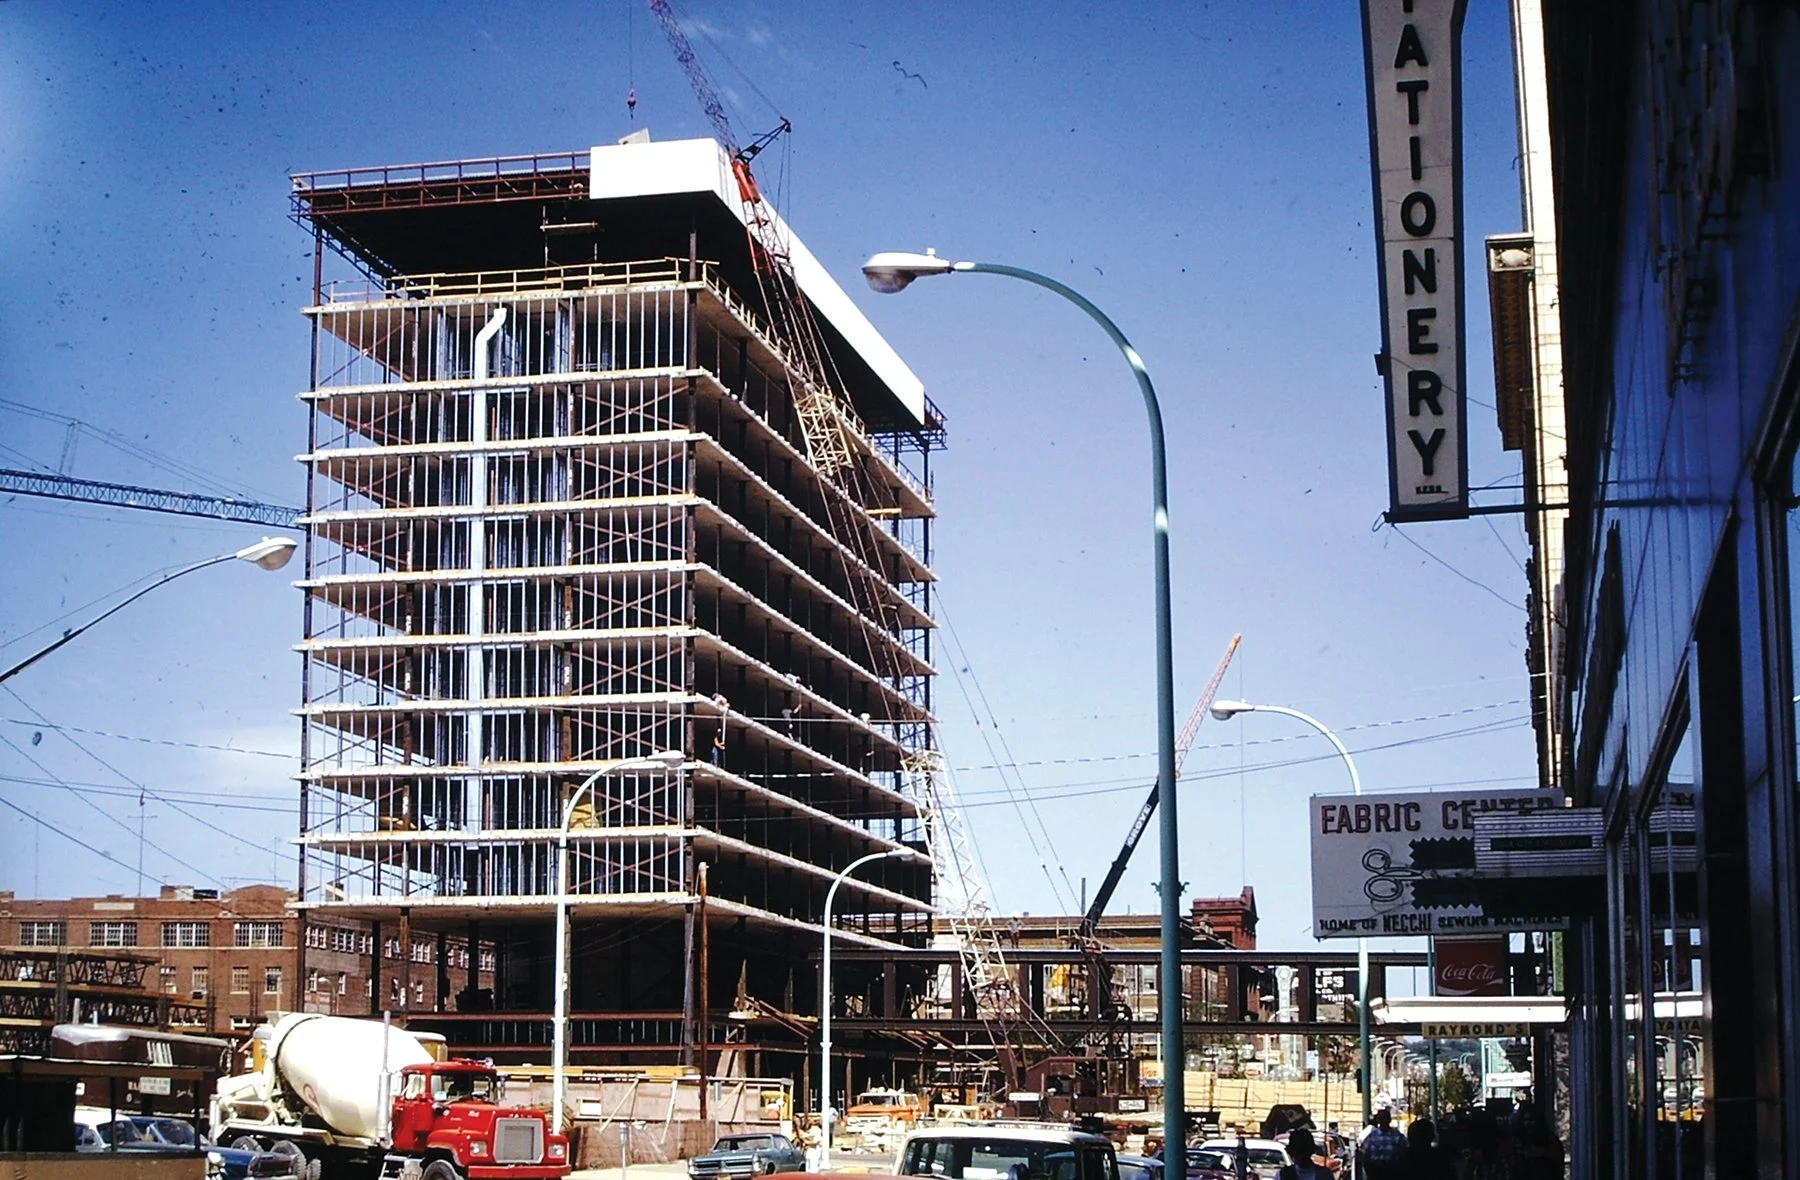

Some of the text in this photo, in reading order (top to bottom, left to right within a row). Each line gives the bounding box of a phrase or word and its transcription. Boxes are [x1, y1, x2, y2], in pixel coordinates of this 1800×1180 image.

[1321, 802, 1421, 834] FABRIC
[1319, 918, 1356, 931] HOME
[1362, 918, 1378, 930] OF
[1383, 913, 1432, 933] NECCHI
[1428, 1022, 1524, 1036] RAYMOND'S
